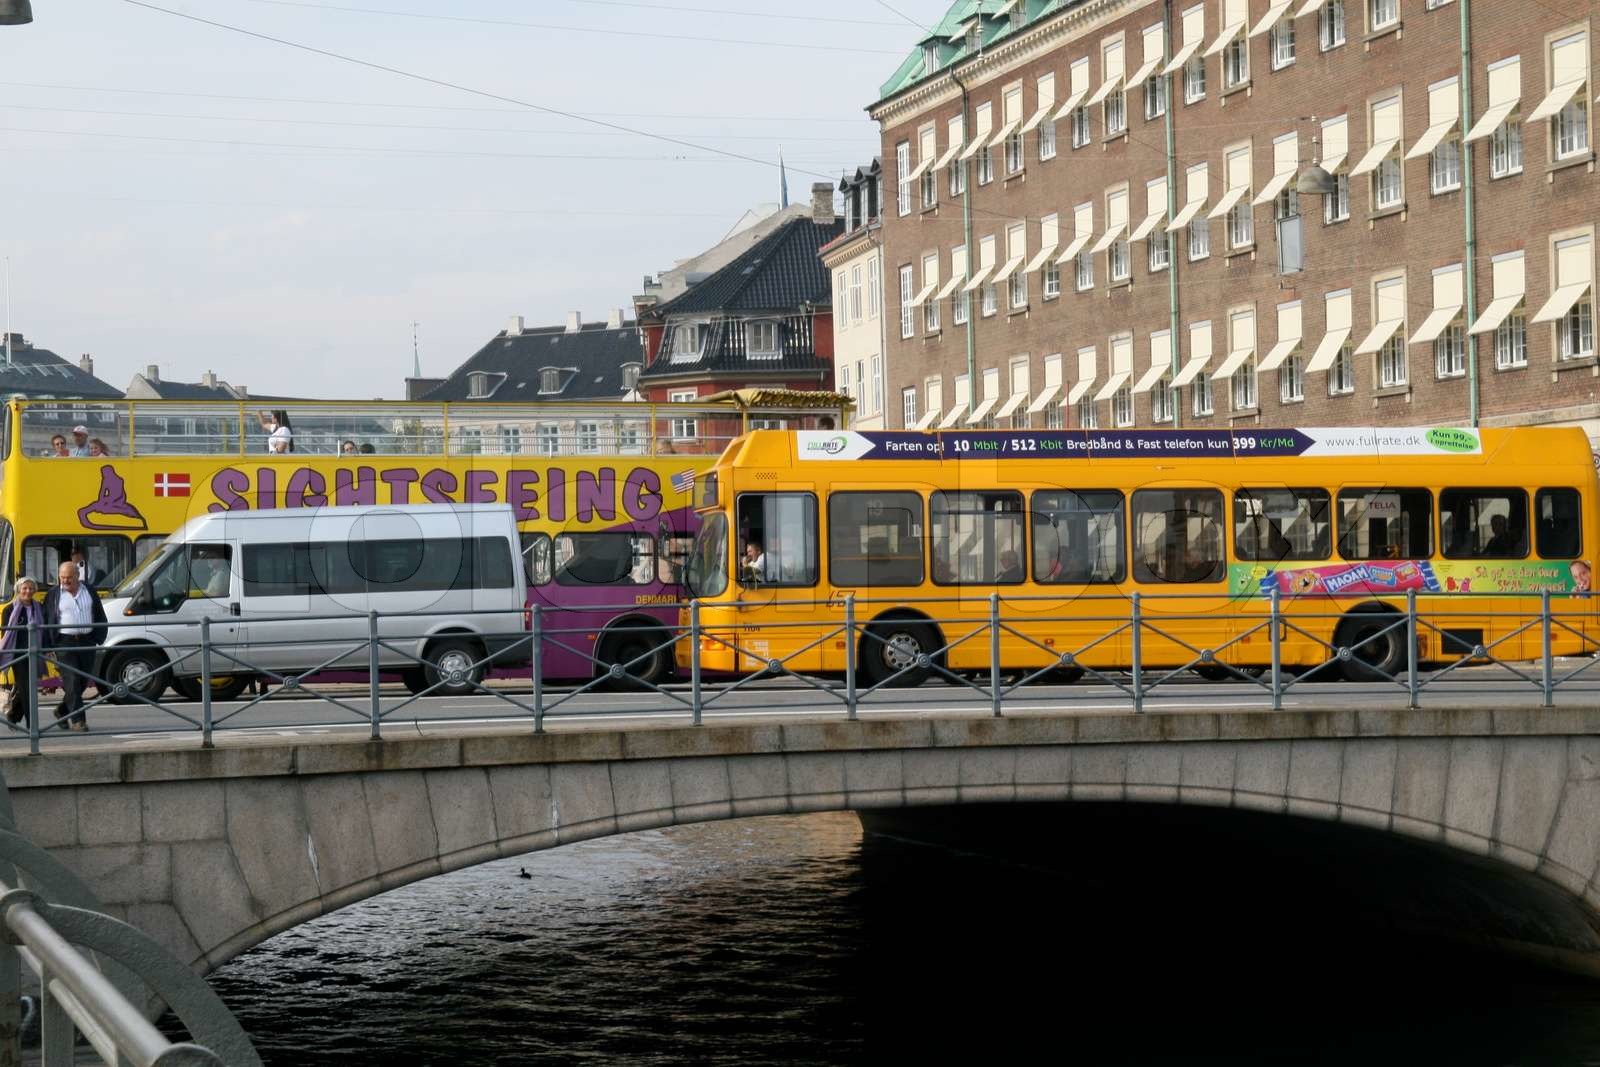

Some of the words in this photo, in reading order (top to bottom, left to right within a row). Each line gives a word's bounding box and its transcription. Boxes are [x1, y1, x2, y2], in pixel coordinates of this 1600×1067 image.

[885, 441, 922, 451] Farten
[953, 440, 970, 452] 10
[973, 439, 998, 450] Mbit
[1011, 439, 1037, 451] 512
[1039, 439, 1063, 450] Kbit
[1066, 437, 1121, 450] Bredbånd
[1125, 439, 1135, 449] &
[1137, 439, 1162, 449] Fast
[1164, 438, 1204, 449] telefon
[1207, 438, 1229, 449] kun
[1233, 437, 1256, 449] 399
[1260, 437, 1295, 449] Kr/Md
[1325, 433, 1421, 448] www.fullrate.dk
[207, 466, 663, 523] SIGHTSEEING
[1326, 565, 1370, 591] MAOAM
